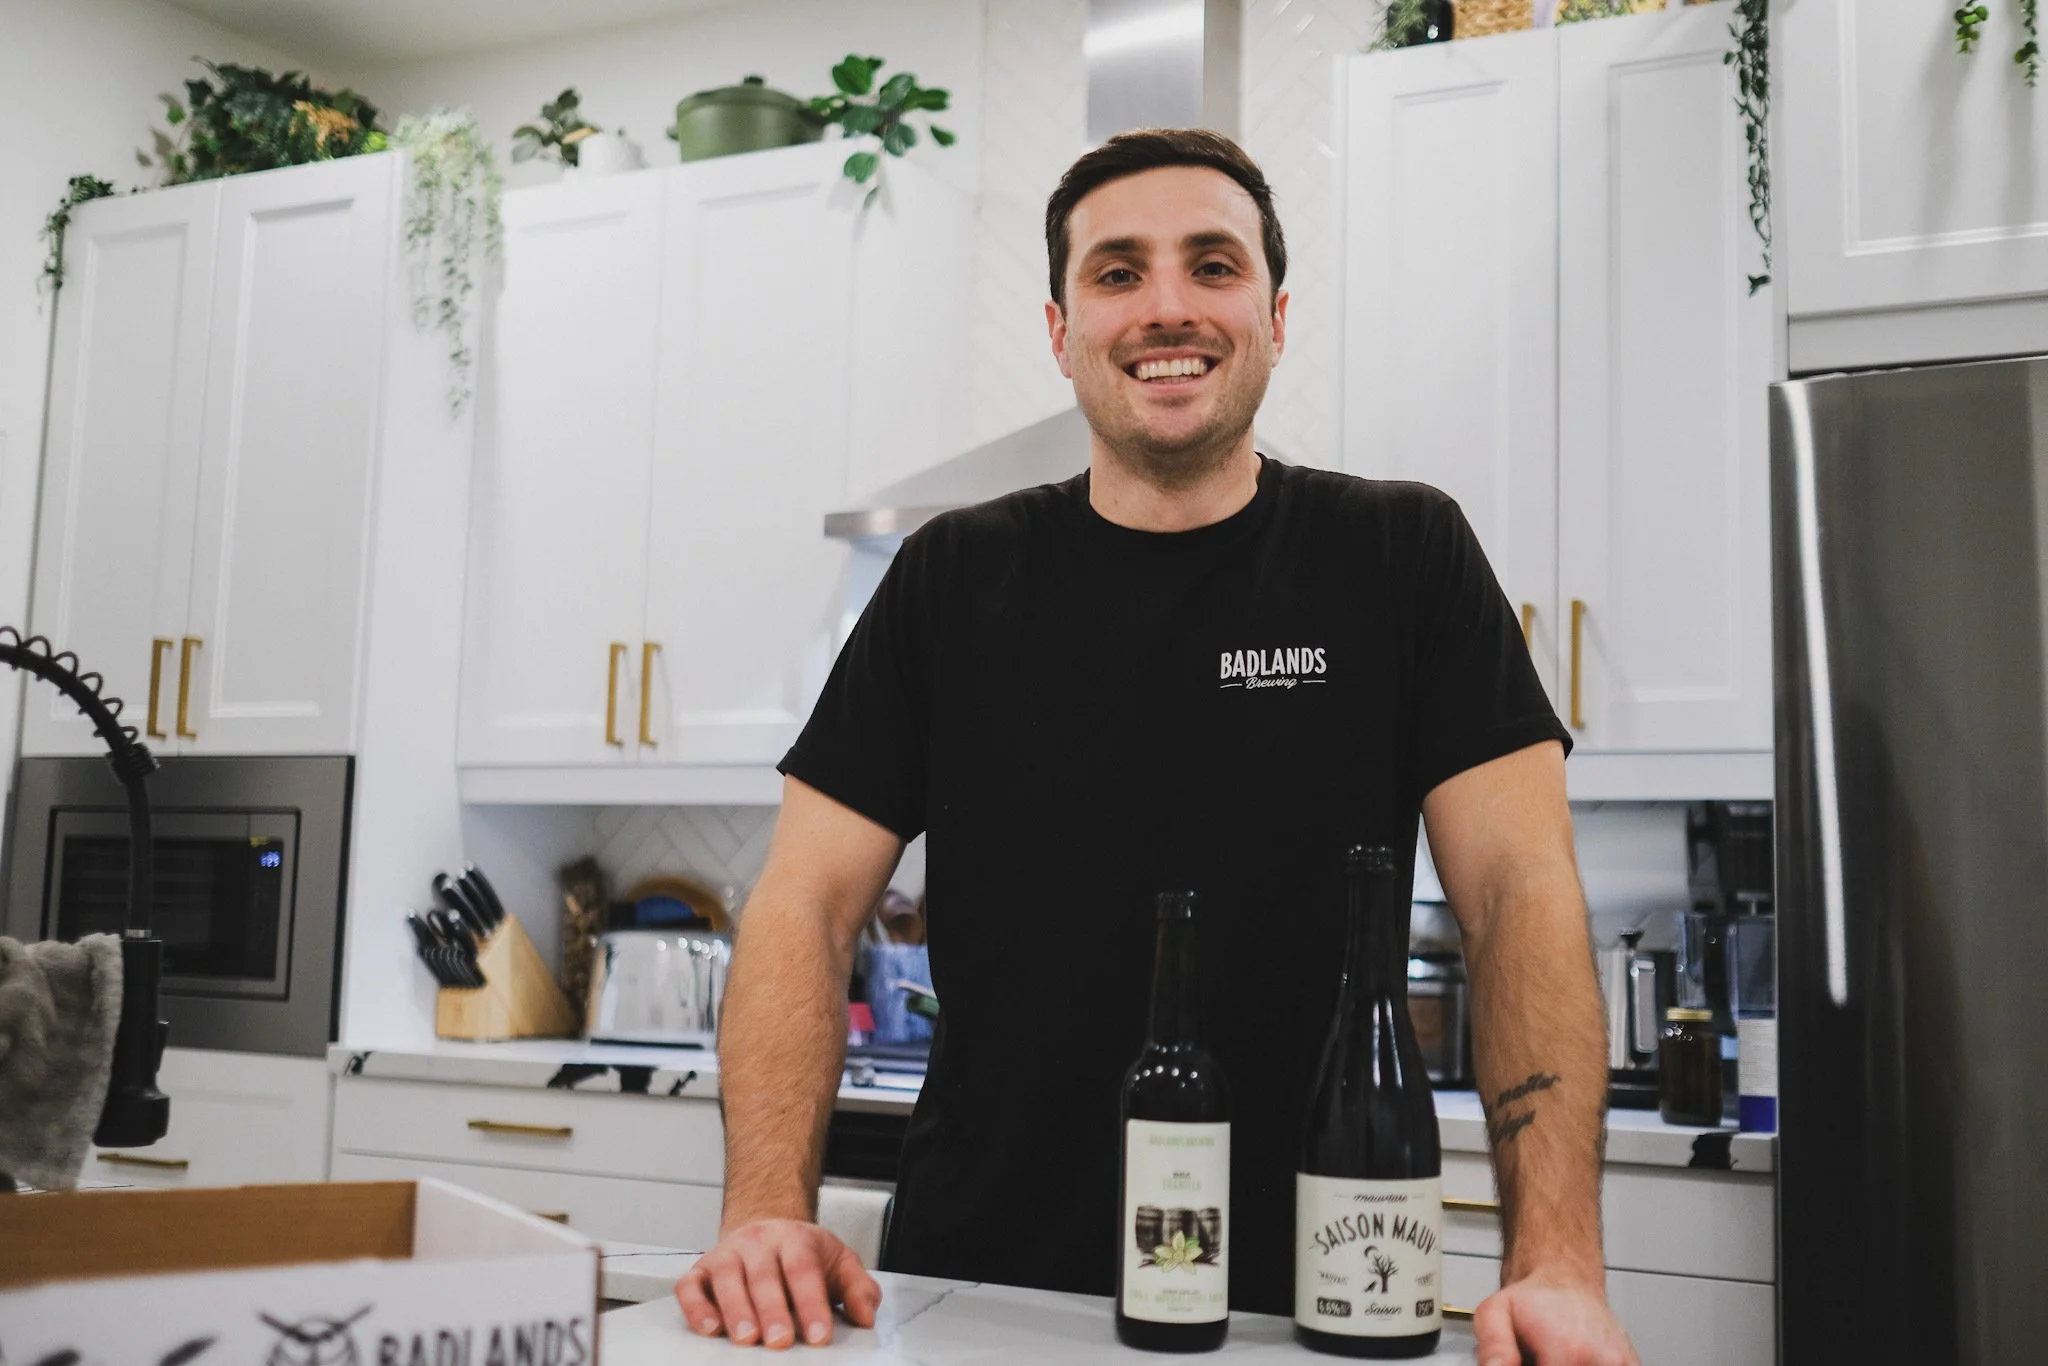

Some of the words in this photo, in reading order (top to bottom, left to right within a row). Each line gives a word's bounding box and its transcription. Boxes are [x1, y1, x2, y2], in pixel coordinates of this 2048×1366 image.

[1220, 647, 1327, 679] BADLANDS
[1245, 676, 1298, 689] Brewing
[1314, 1212, 1385, 1255] SAISON
[1392, 1213, 1436, 1255] MAUV
[1364, 1301, 1402, 1316] Saison
[378, 1317, 588, 1366] BADLANDS
